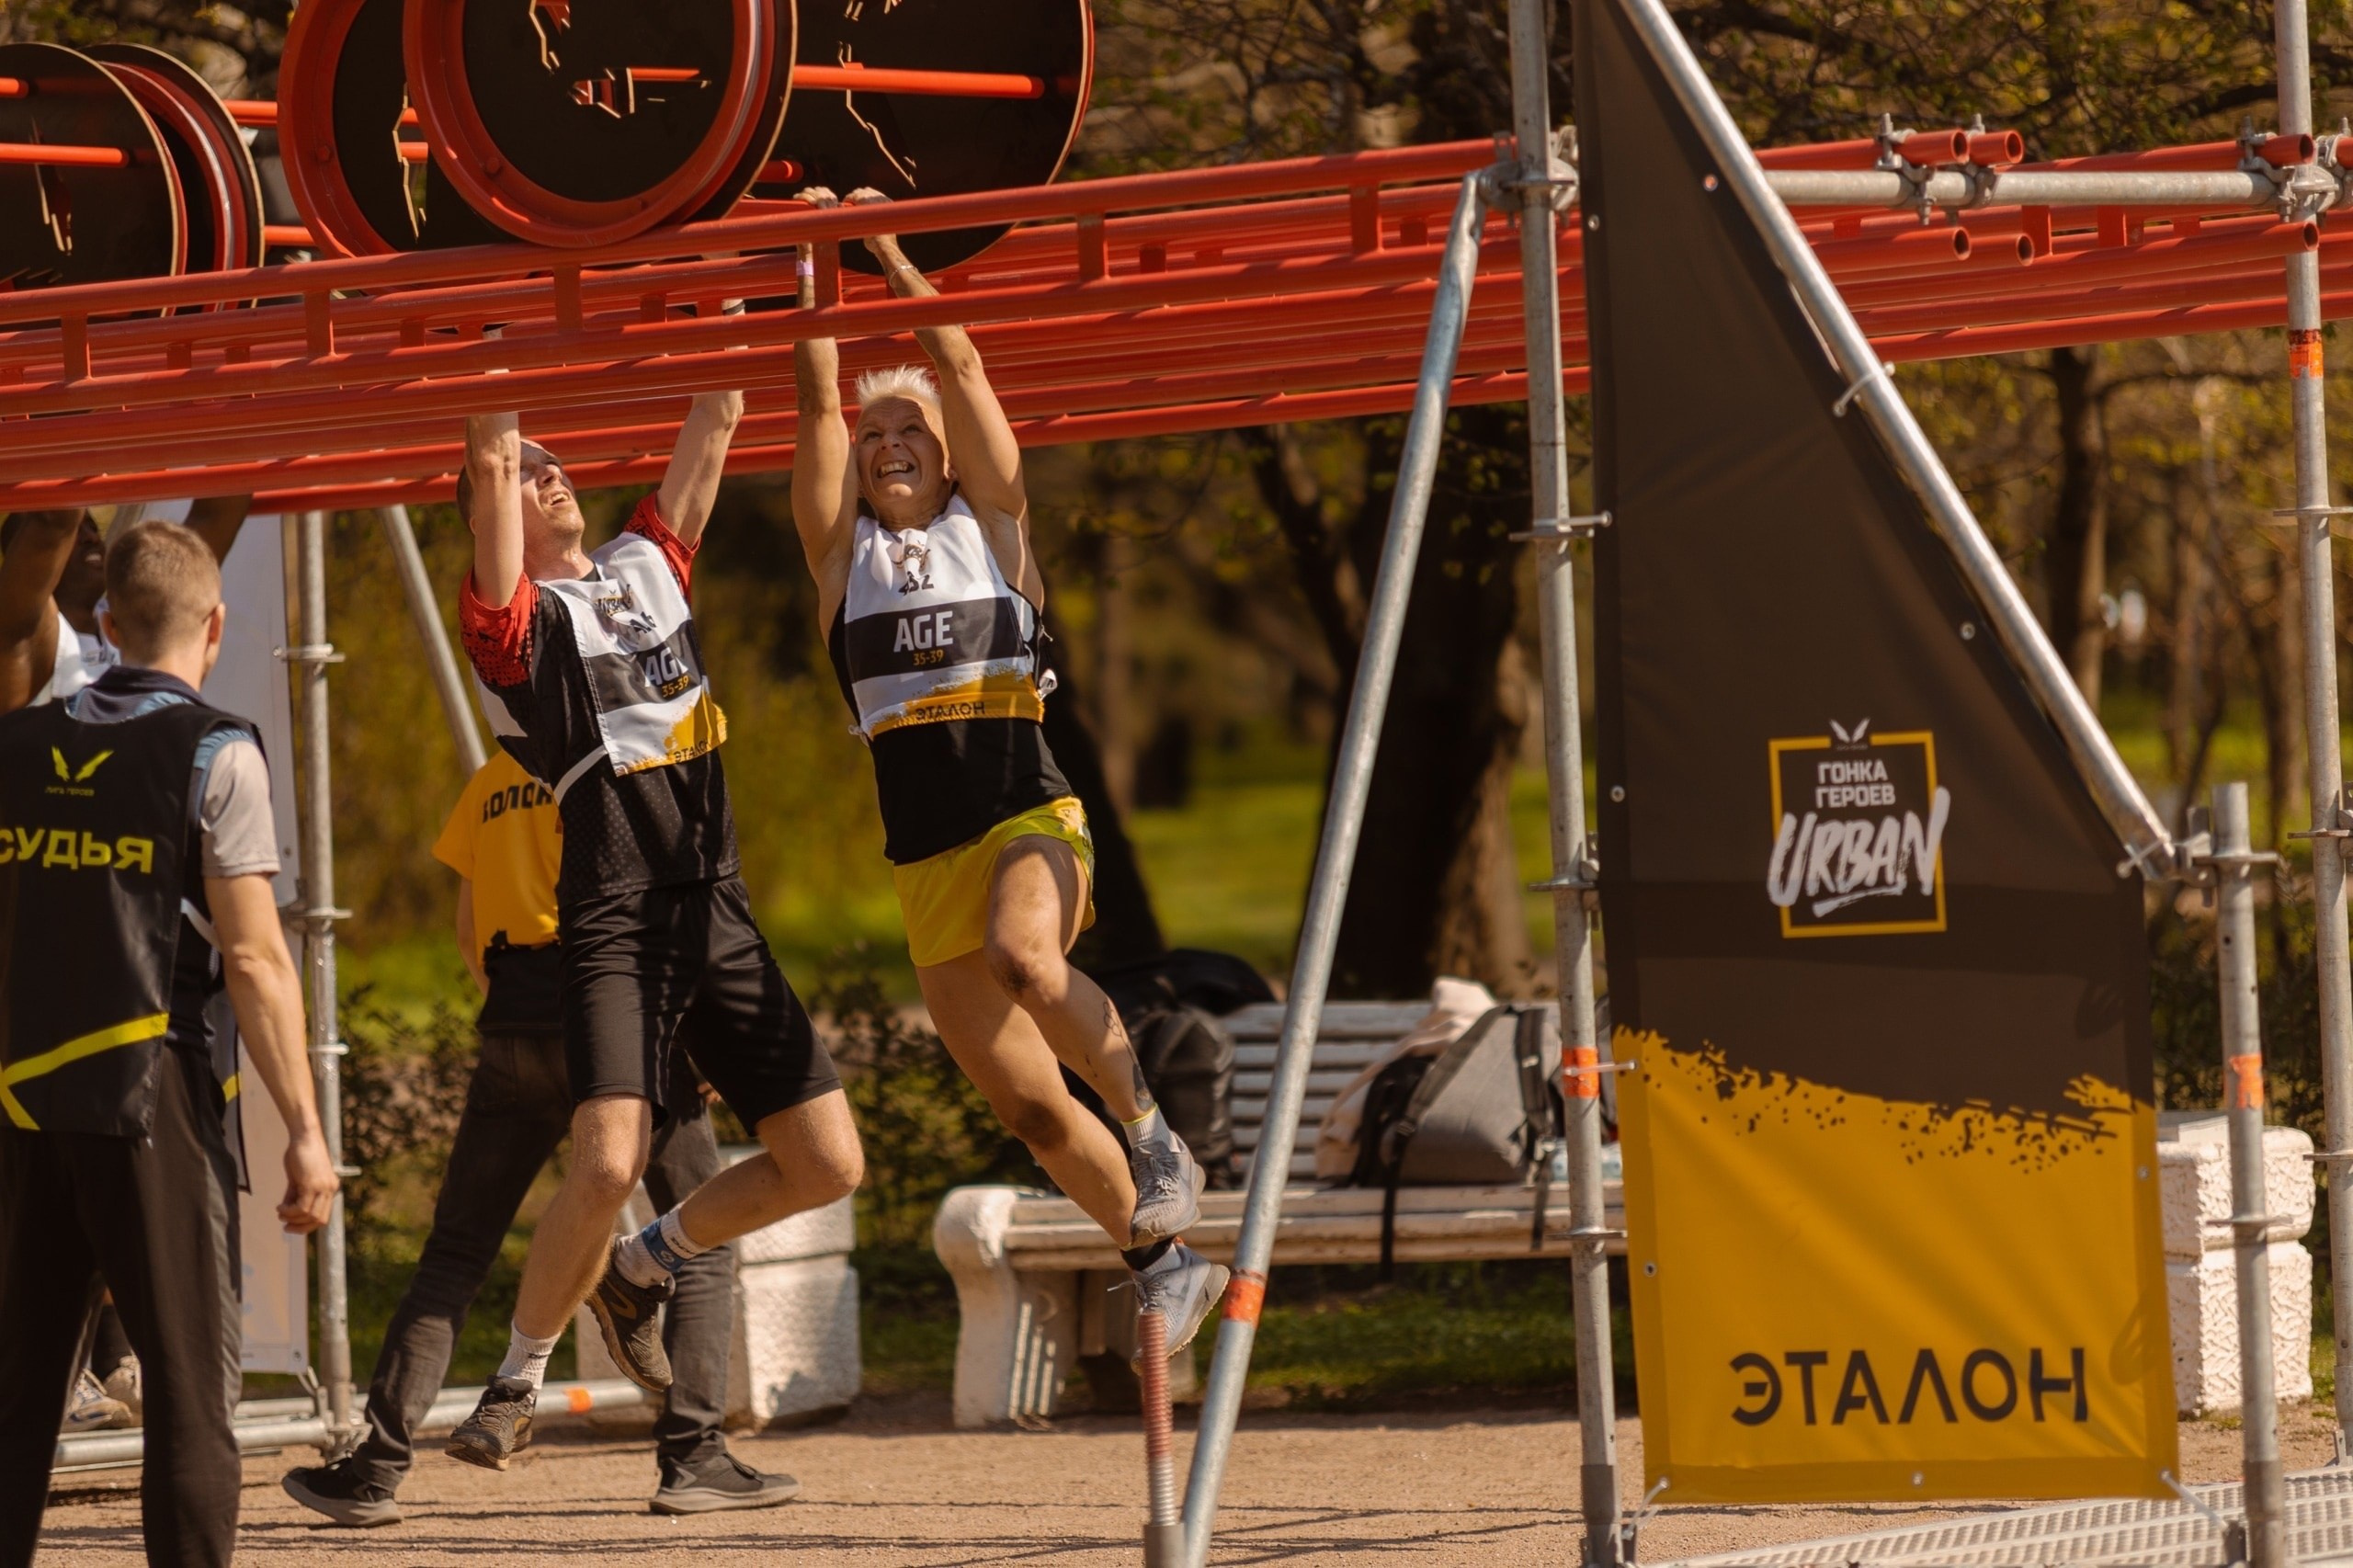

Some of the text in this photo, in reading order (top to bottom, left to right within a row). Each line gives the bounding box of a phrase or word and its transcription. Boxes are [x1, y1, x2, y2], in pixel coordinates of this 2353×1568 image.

[892, 610, 954, 653] AGE
[645, 646, 688, 686] AG
[913, 648, 944, 665] 35-39
[662, 676, 689, 698] 35-39
[915, 701, 986, 720] ЭТАЛОН
[1817, 759, 1888, 784] ГОНКА
[1815, 783, 1896, 809] ГЕРОЕВ
[0, 827, 154, 874] СУДЬЯ
[1766, 785, 1951, 908] URBAN
[1728, 1347, 2088, 1426] ЭТАЛОН
